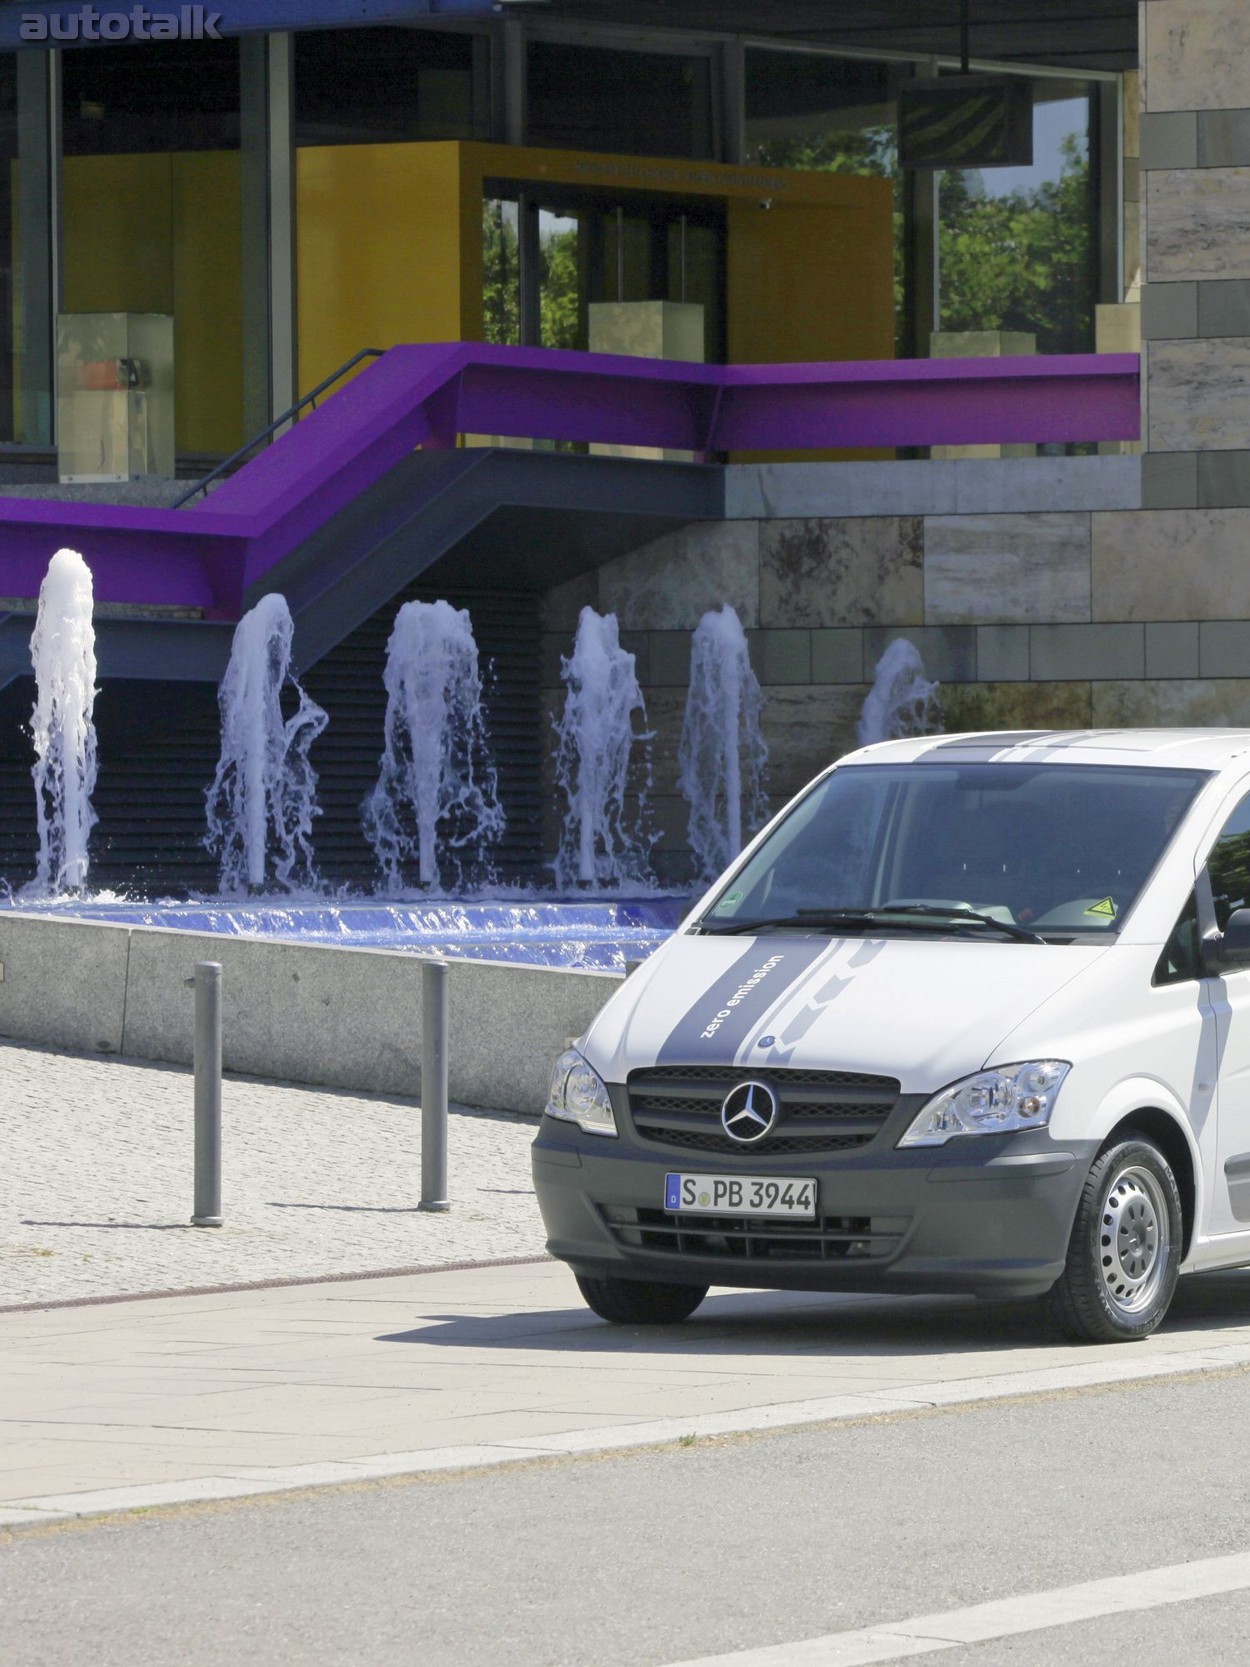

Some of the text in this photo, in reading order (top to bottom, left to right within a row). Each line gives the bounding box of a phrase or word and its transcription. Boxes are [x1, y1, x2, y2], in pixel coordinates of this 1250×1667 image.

[700, 955, 784, 1038] zero emission
[682, 1178, 811, 1211] S PB 3944
